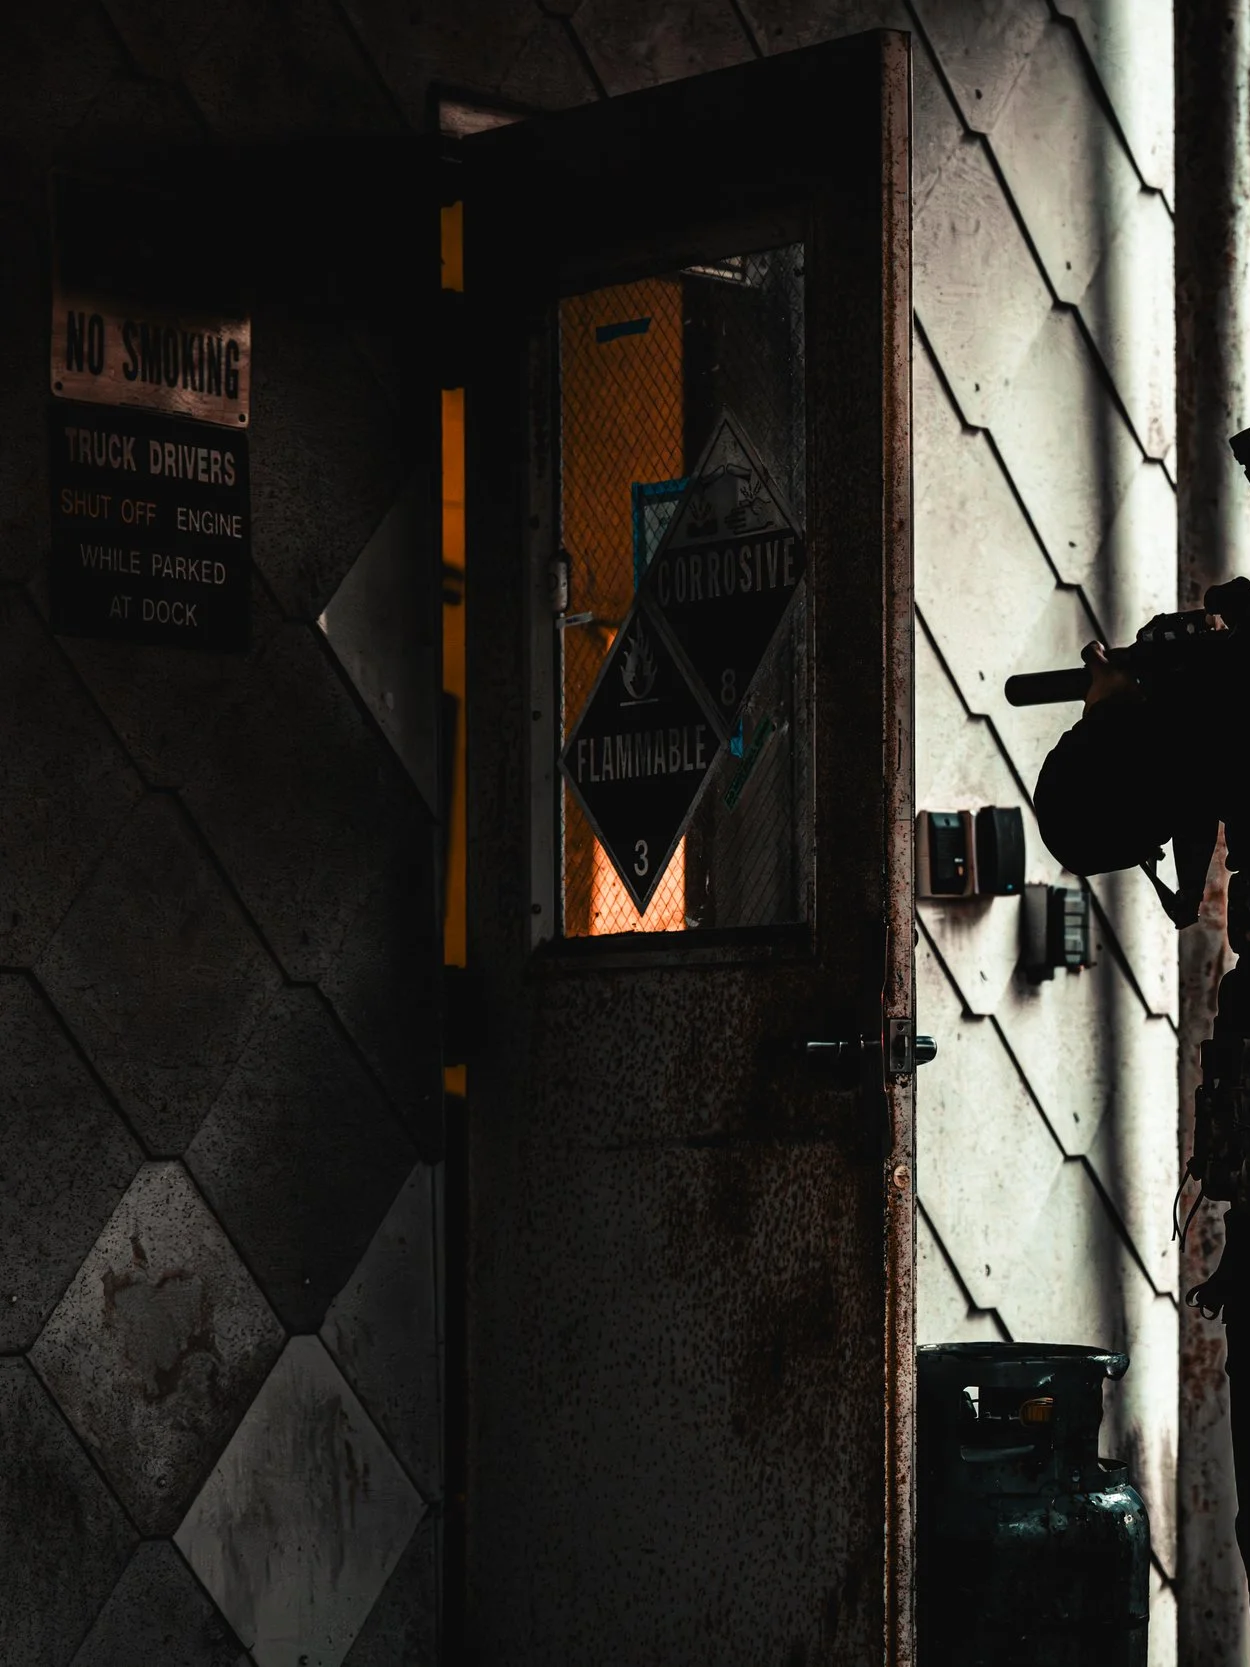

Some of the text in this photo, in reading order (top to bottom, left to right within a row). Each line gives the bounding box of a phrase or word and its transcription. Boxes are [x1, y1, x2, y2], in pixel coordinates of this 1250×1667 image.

[67, 310, 239, 400] NO SMOKING
[64, 426, 236, 487] TRUCK DRIVERS
[61, 488, 243, 540] SHUT OFF ENGINE
[80, 543, 226, 585] WHILE PARKED
[657, 536, 796, 608] CORROSIVE
[109, 594, 198, 627] AT DOCK
[720, 667, 736, 706] 8
[577, 724, 708, 784] FLAMMABLE
[633, 839, 649, 877] 3
